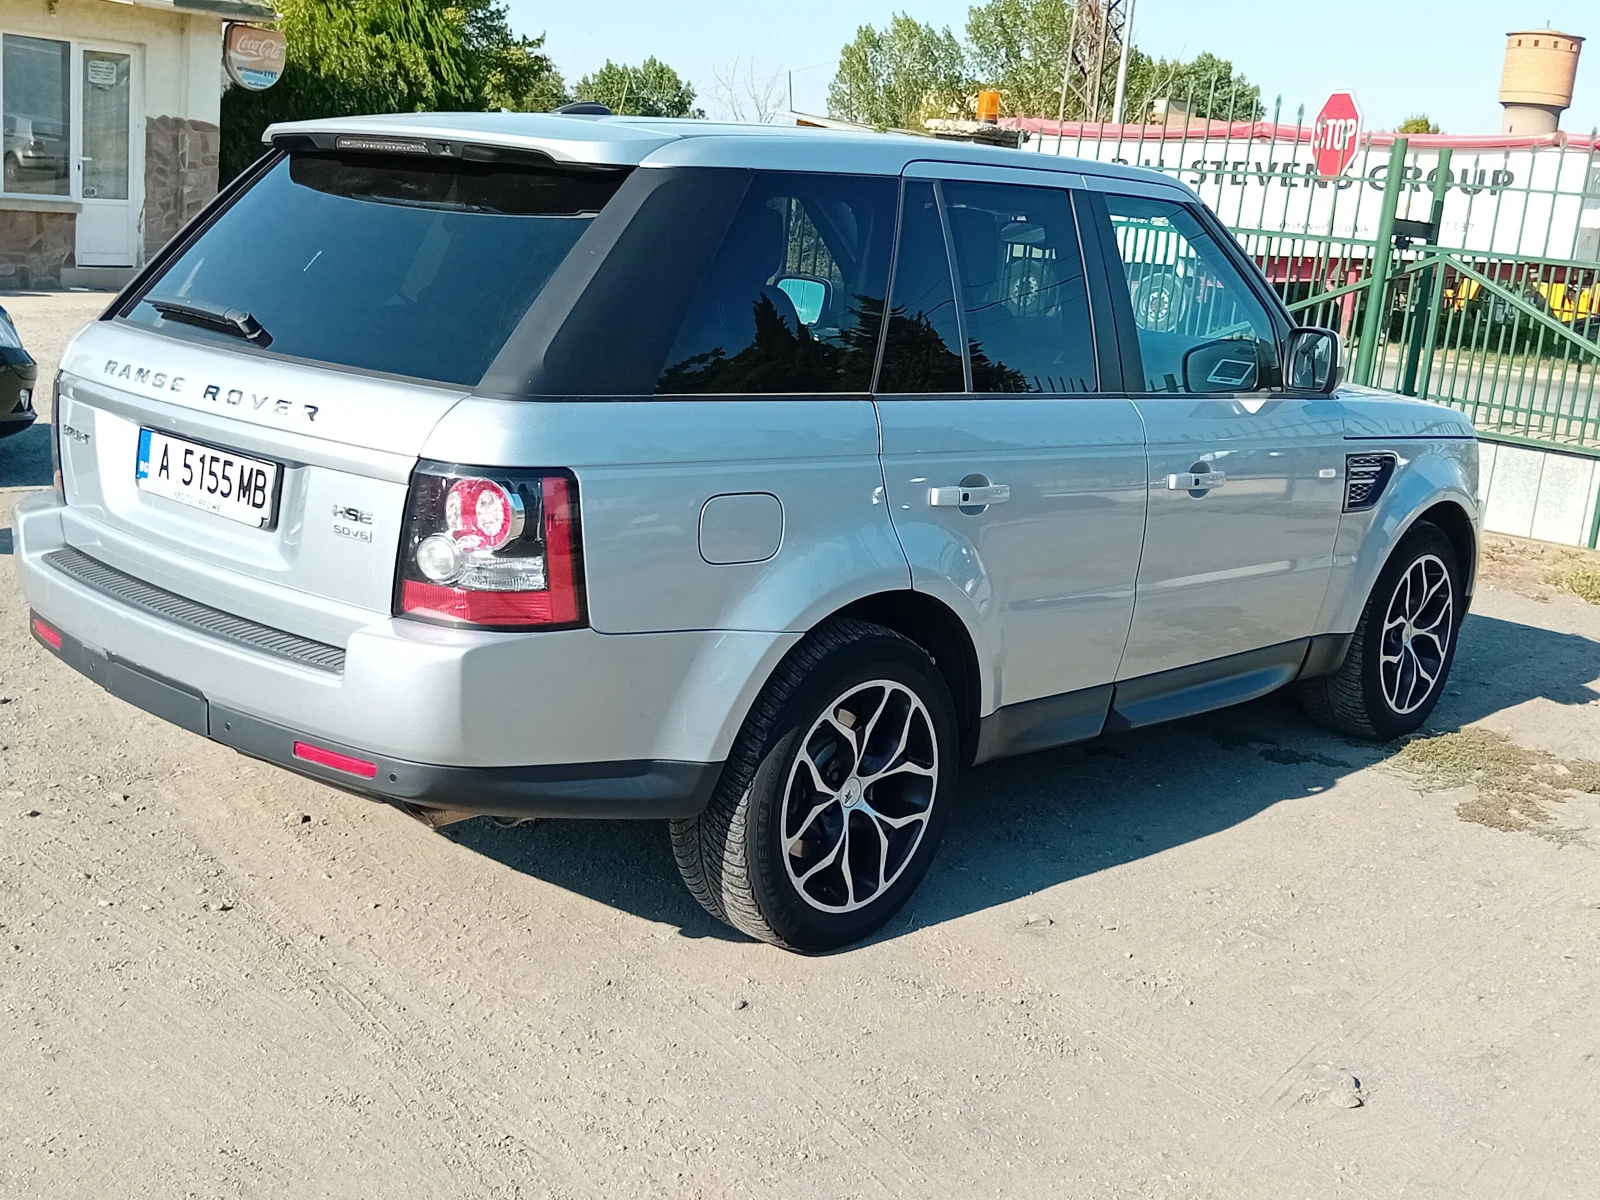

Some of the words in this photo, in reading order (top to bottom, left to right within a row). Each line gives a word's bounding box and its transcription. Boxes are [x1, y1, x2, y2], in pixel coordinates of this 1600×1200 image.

[1314, 118, 1357, 151] STOP
[1368, 164, 1515, 196] GROUP
[103, 359, 187, 393] RANGE
[203, 384, 319, 421] ROVER
[158, 443, 170, 480] A
[181, 448, 234, 498] 5155
[237, 465, 267, 509] MB
[333, 504, 373, 525] HSE
[333, 524, 369, 541] SDV6
